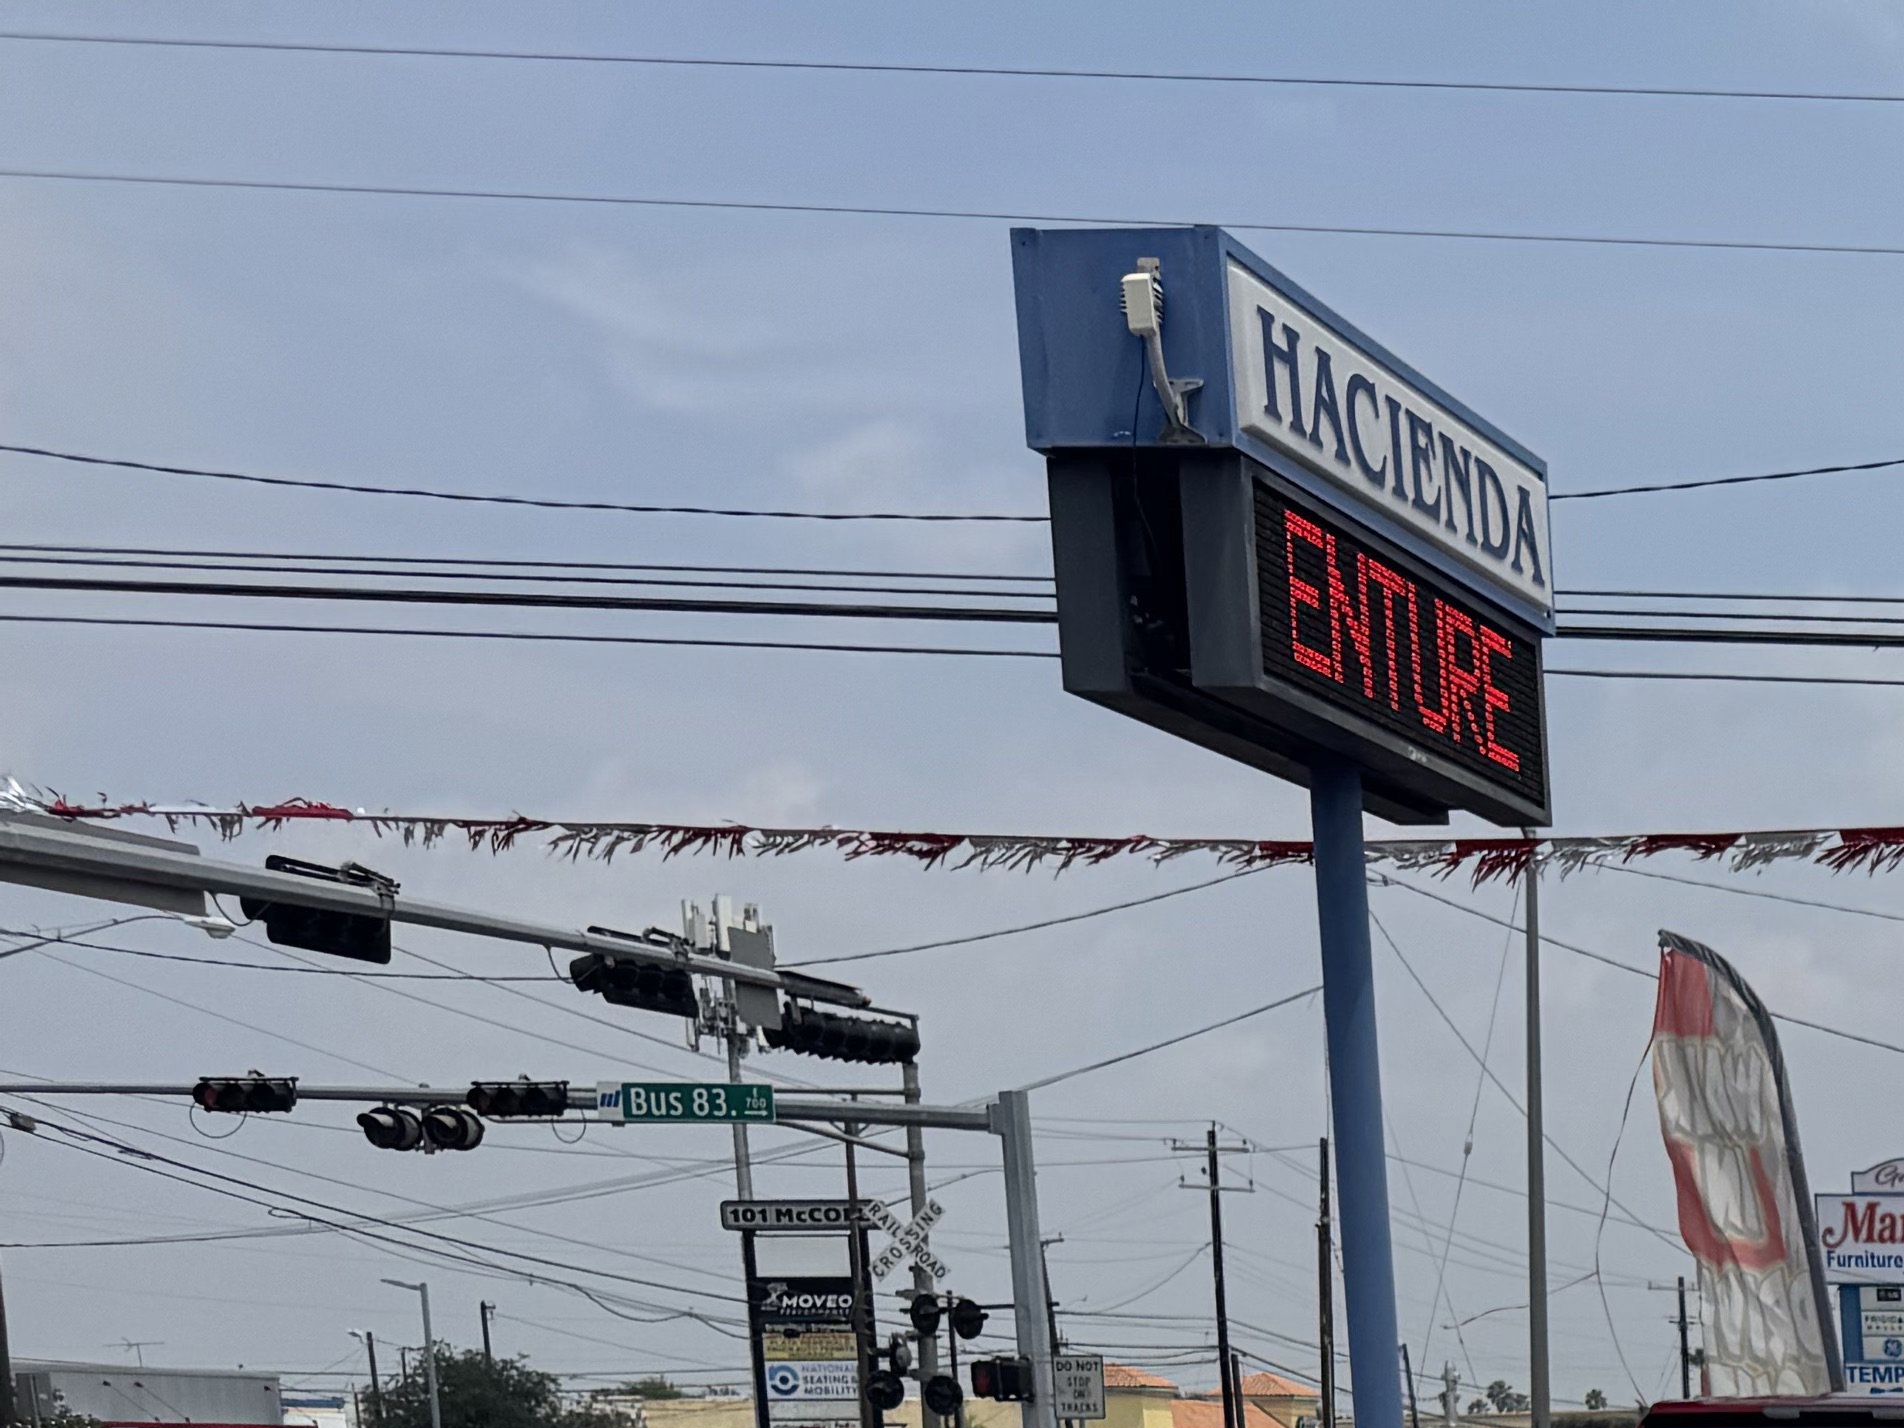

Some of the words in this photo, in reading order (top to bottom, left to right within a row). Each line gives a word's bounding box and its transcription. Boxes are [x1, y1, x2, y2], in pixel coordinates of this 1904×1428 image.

[1256, 304, 1545, 587] HACIENDA
[1283, 508, 1521, 773] ENTURE
[630, 1087, 683, 1116] Bus
[745, 1097, 767, 1109] 700
[729, 1208, 769, 1223] 101
[871, 1202, 944, 1279] CROSSING
[1827, 1251, 1904, 1269] Furniture
[782, 1294, 853, 1308] MOVEO
[1056, 1361, 1072, 1372] DO
[1076, 1361, 1099, 1372] NOT
[803, 1386, 857, 1396] MOBILITY
